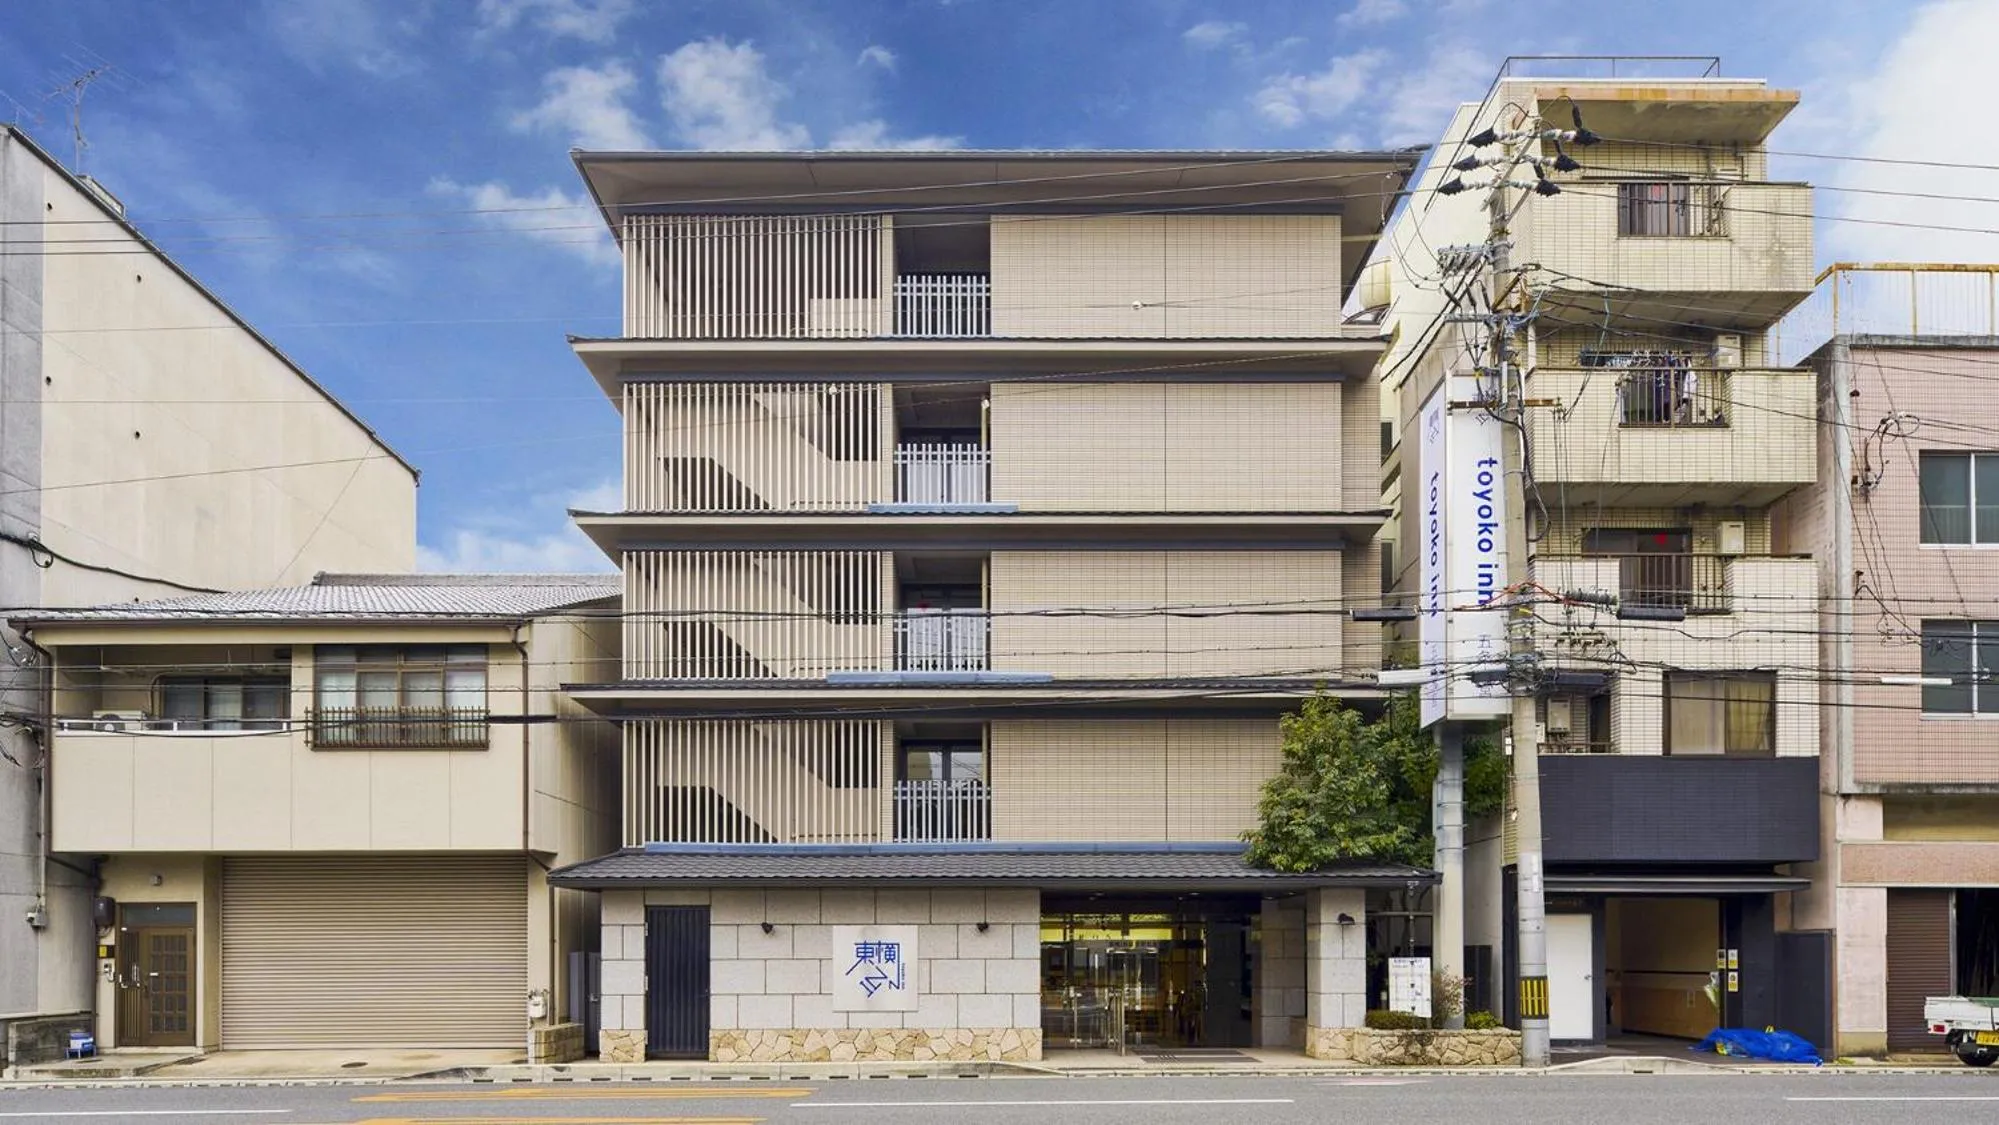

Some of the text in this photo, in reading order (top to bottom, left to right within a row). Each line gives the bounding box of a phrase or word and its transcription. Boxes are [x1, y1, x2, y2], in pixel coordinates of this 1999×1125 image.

[1429, 471, 1440, 567] toyoko
[1472, 457, 1498, 606] toyoko inn
